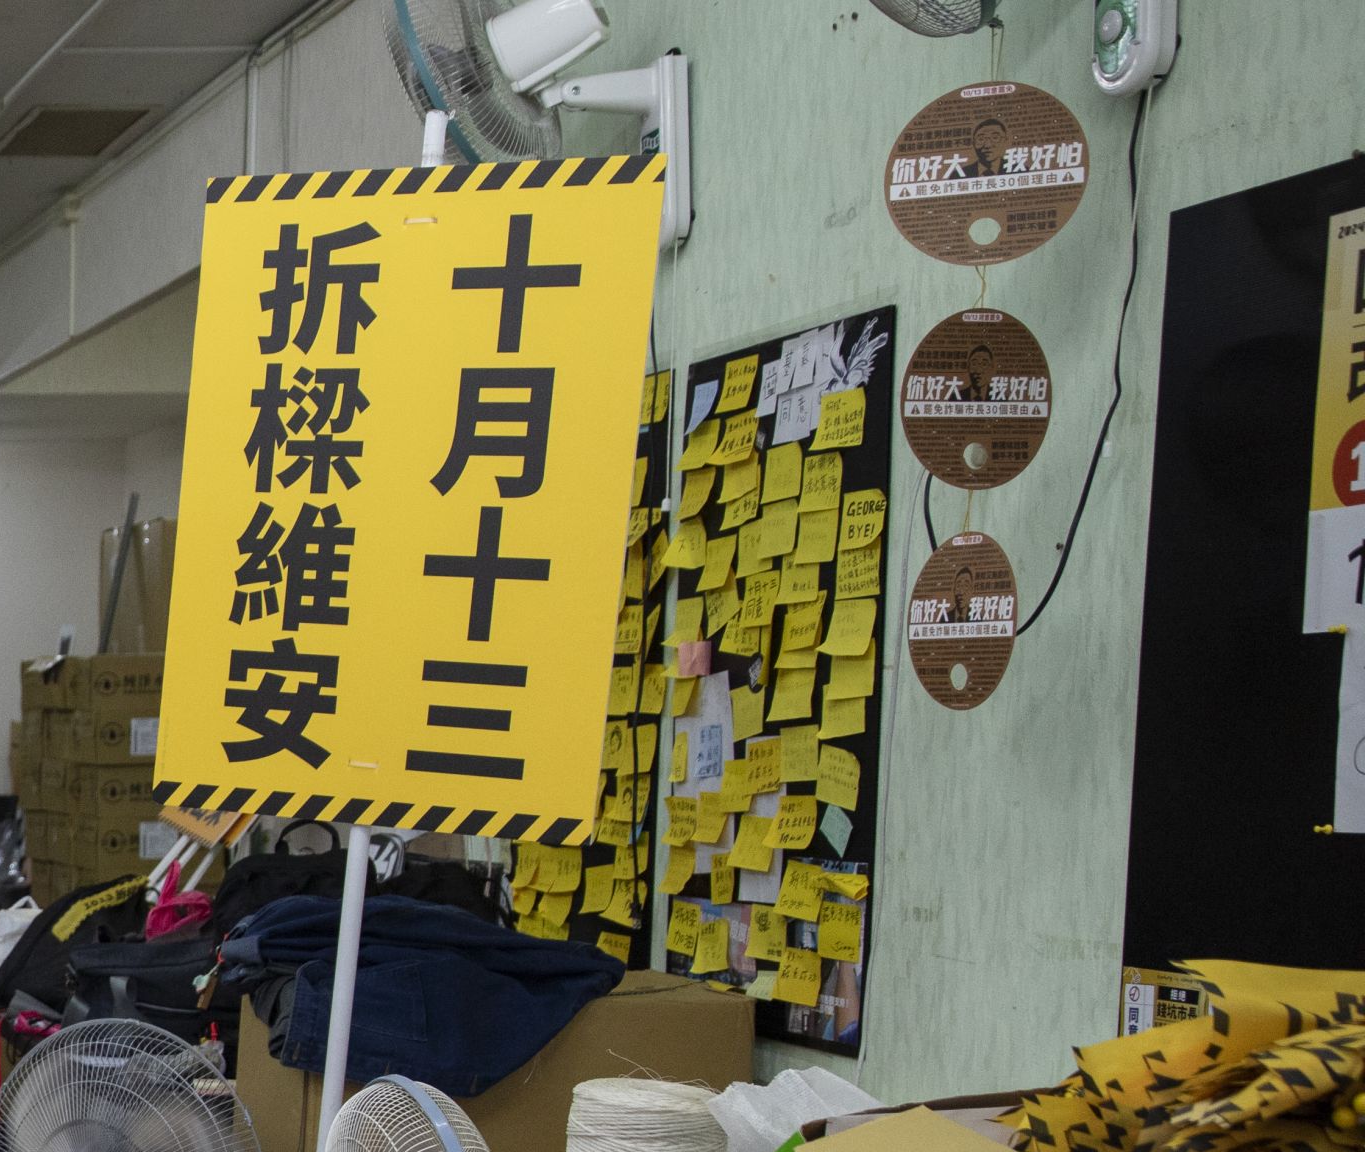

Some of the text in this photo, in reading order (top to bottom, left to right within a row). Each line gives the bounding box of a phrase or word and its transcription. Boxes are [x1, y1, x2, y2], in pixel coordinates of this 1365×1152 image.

[892, 142, 1083, 184] 你好大 我好怕
[915, 174, 1058, 197] 罷免詐騙市長30個理由
[907, 375, 1048, 401] 你好大 我好怕
[221, 221, 381, 770] 拆樑維安
[406, 213, 582, 780] 十月十三
[846, 498, 886, 517] GEORGE
[847, 523, 875, 540] BYE!
[910, 595, 1014, 624] 你好大 我好怕
